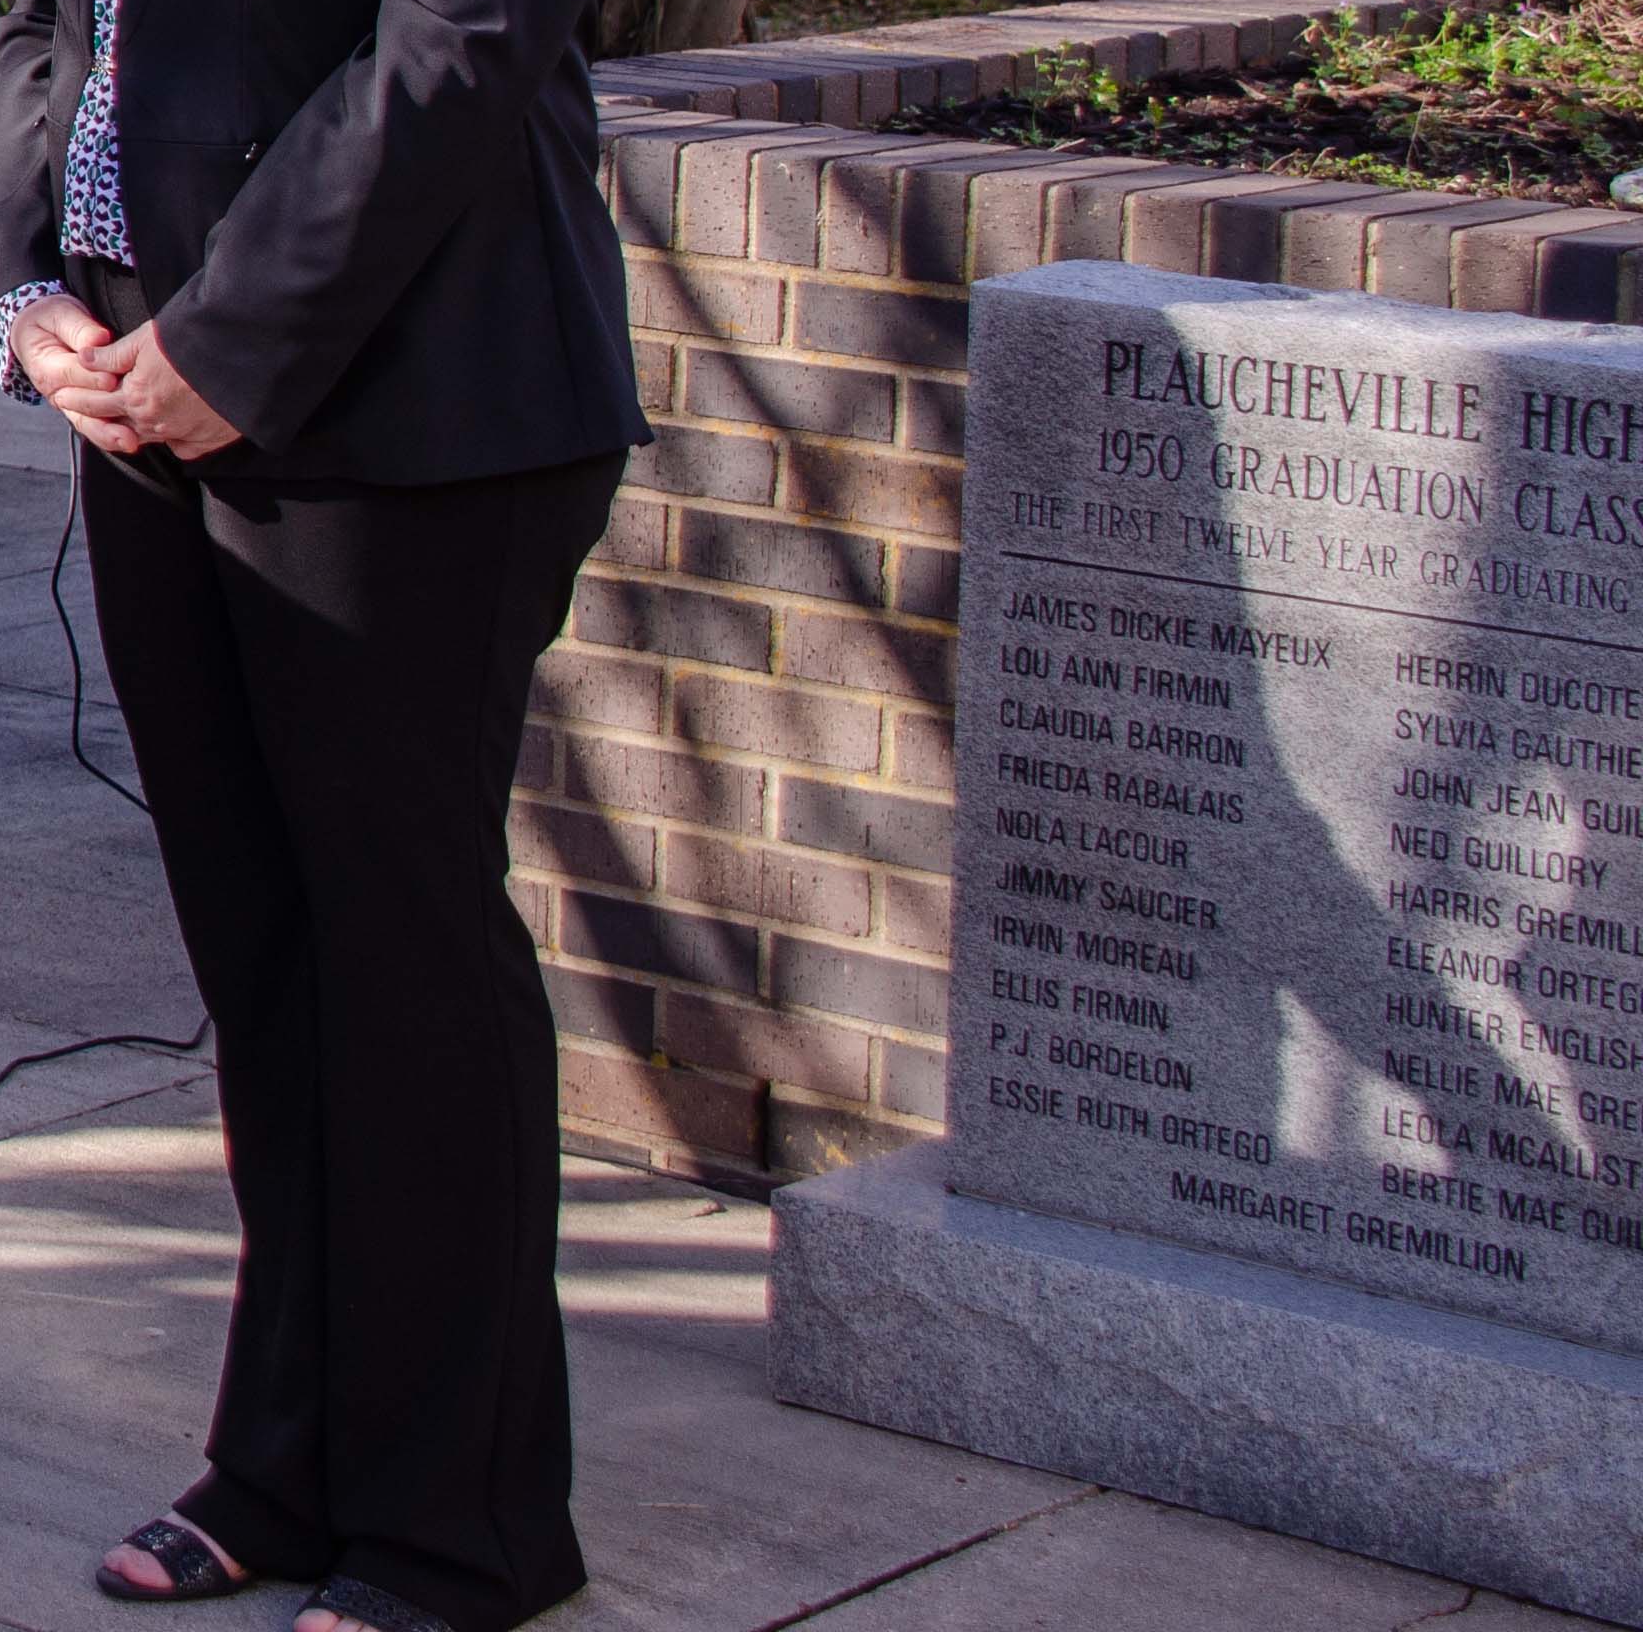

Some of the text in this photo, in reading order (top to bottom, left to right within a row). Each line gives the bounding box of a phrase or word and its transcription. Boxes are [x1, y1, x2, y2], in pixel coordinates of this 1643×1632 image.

[1101, 339, 1481, 443] PLAUCHEVILLE
[1098, 427, 1184, 482] 1950
[1211, 442, 1484, 523] GRADUATION
[1010, 490, 1628, 613] THE FIRST TWELVE YEAR GRADUATING
[1004, 592, 1331, 669] JAMES DICKIE MAYEUX
[1001, 644, 1231, 709] LOU ANN FIRMIN
[1396, 652, 1505, 698] HERRIN
[1000, 698, 1244, 768] CLAUDIA BARRON
[1395, 708, 1497, 754] SYLVIA
[998, 753, 1244, 824] FRIEDA RABALAIS
[1394, 768, 1472, 809] JOHN
[1486, 783, 1565, 824] JEAN
[997, 807, 1188, 868] NOLA LACOUR
[1391, 822, 1608, 891] NED GUILLORY
[996, 864, 1216, 930] JIMMY SAUCIER
[1389, 879, 1500, 928] HARRIS
[993, 917, 1195, 981] IRVIN MOREAU
[1387, 936, 1643, 1014] ELEANOR ORTEG
[992, 969, 1167, 1031] ELLIS FIRMIN
[1386, 993, 1503, 1044] HUNTER
[990, 1023, 1193, 1092] P.J. BORDELON
[1385, 1049, 1643, 1133] NELLIE MAE GRE
[989, 1076, 1271, 1166] ESSIE RUTH ORTEGO
[1383, 1105, 1643, 1190] LEOLA MCALLIST
[1171, 1171, 1524, 1282] MARGARET GREMILLION
[1382, 1163, 1482, 1214] BERTIE
[1498, 1189, 1566, 1233] MAE
